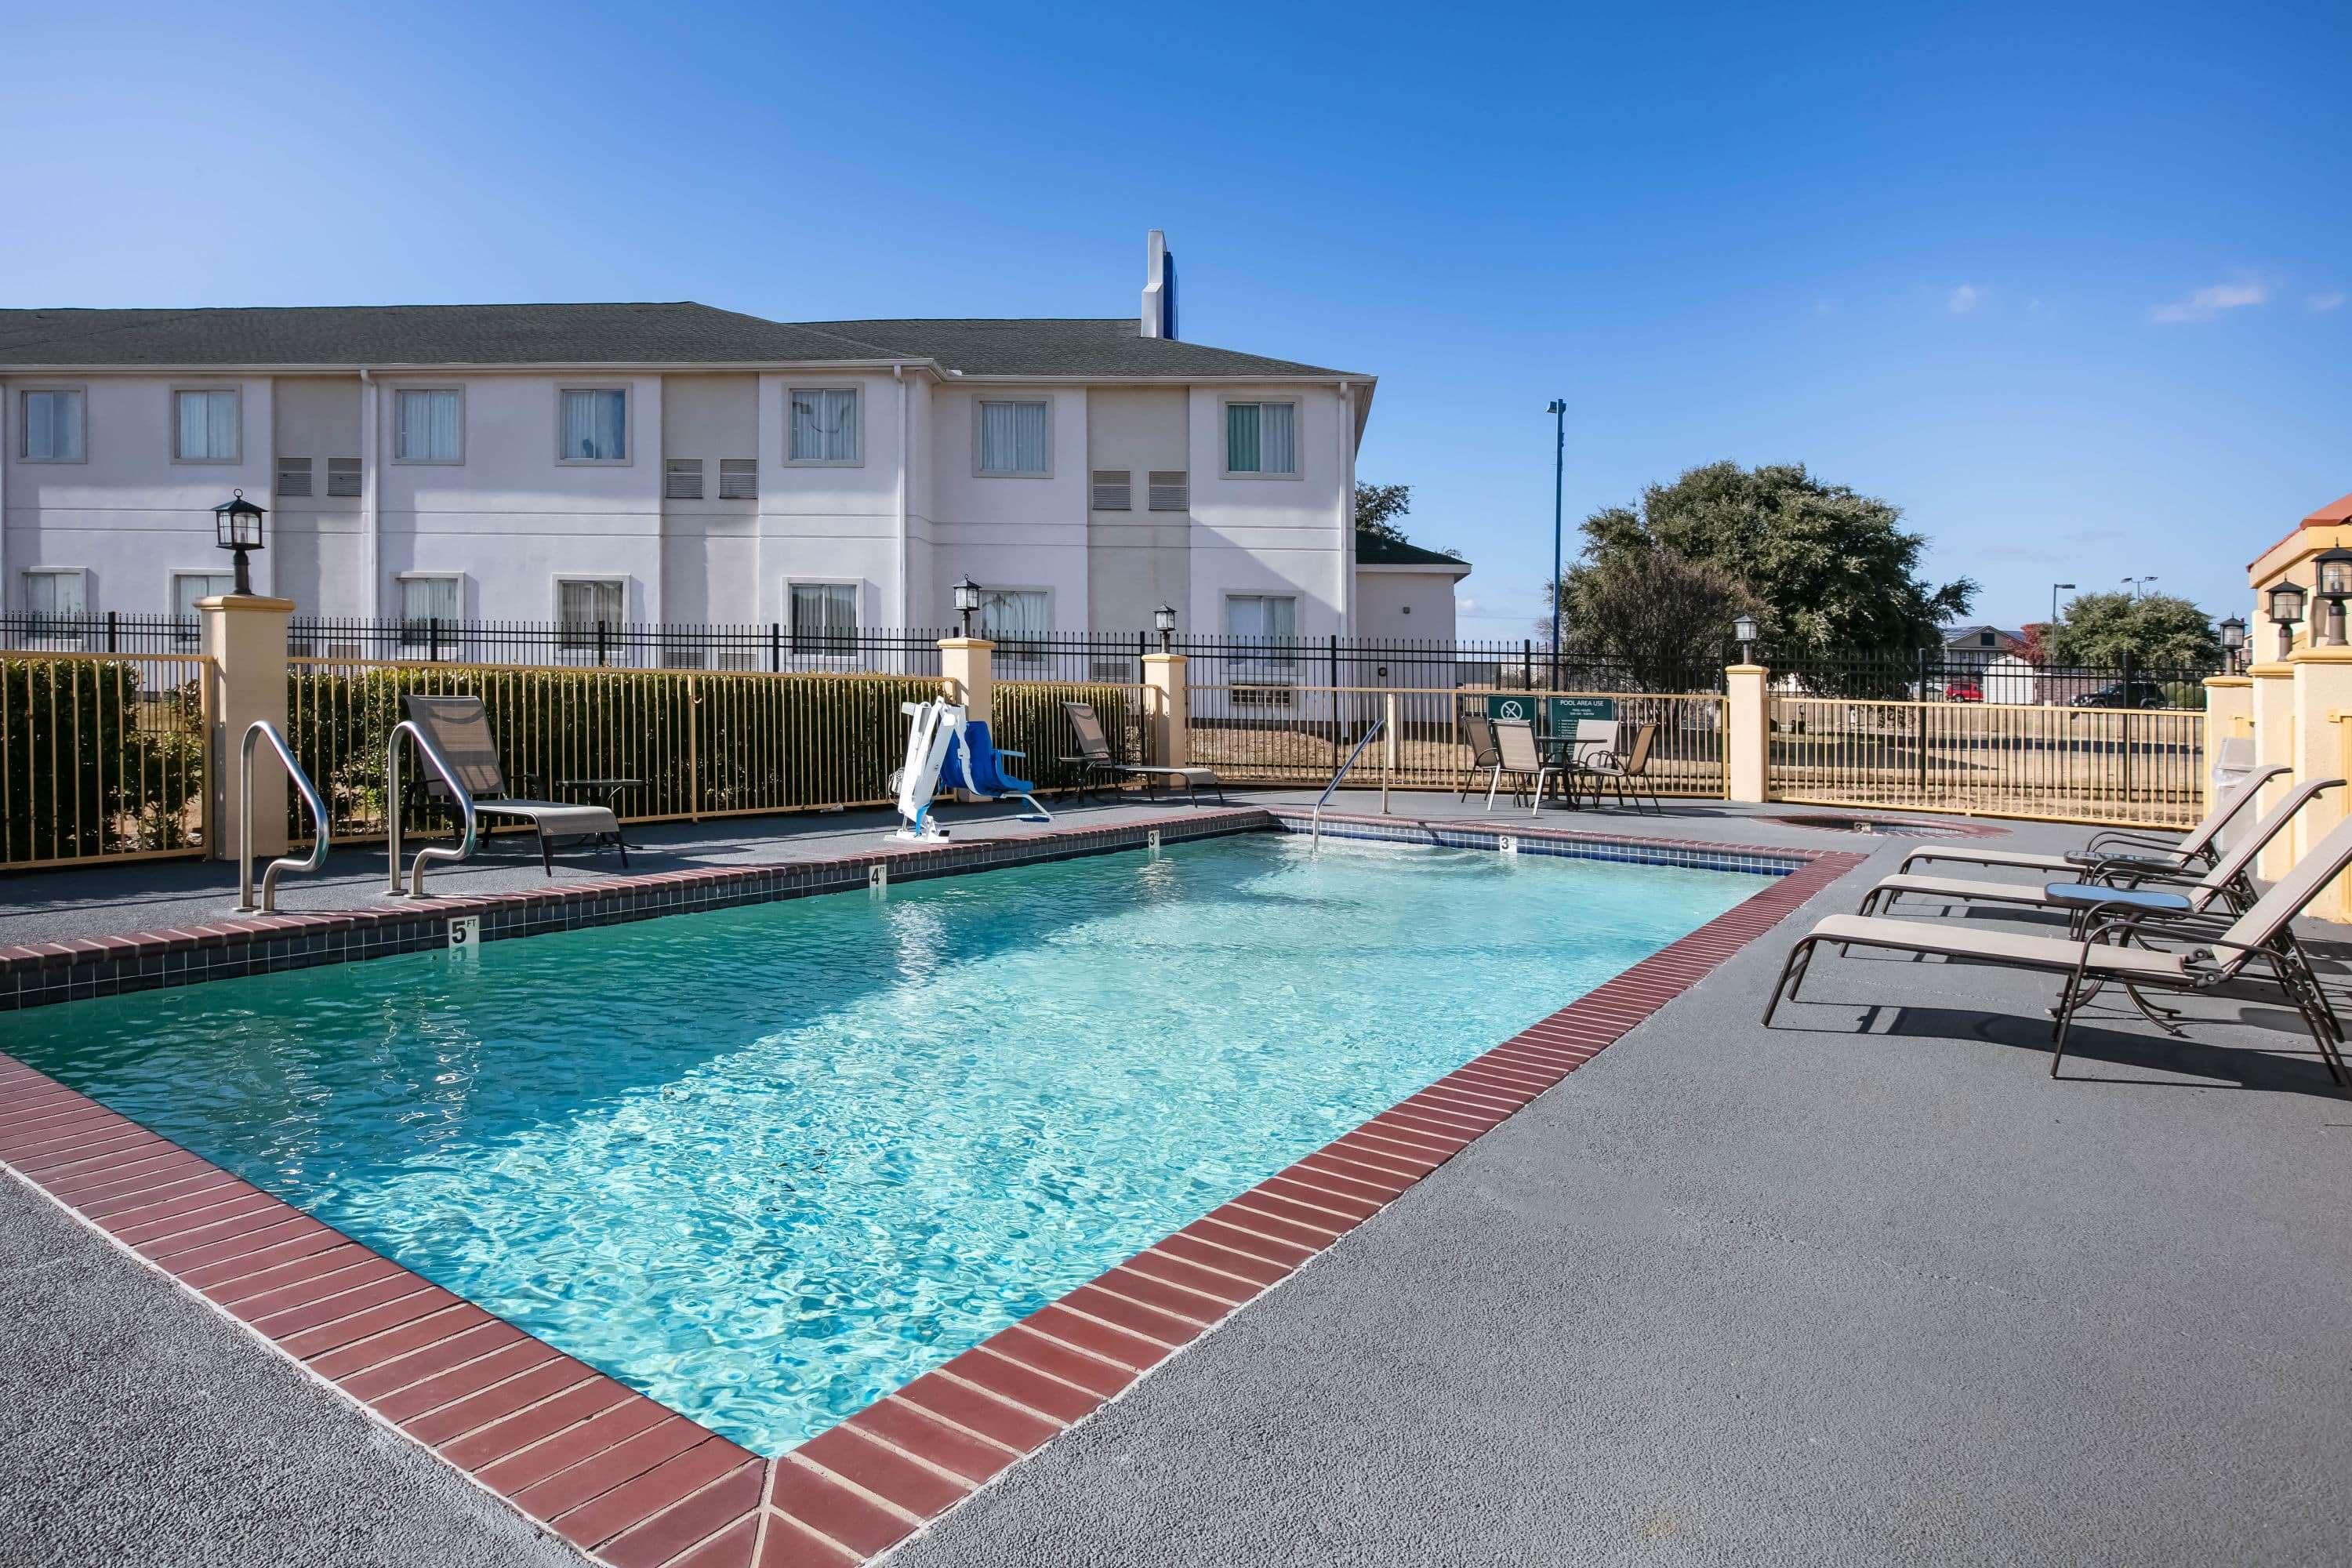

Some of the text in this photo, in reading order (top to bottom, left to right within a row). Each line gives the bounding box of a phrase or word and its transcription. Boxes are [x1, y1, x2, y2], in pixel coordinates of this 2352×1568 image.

[1149, 833, 1155, 846] 3
[1501, 837, 1509, 850] 3
[871, 868, 880, 884] 4
[452, 918, 477, 944] 5 FT
